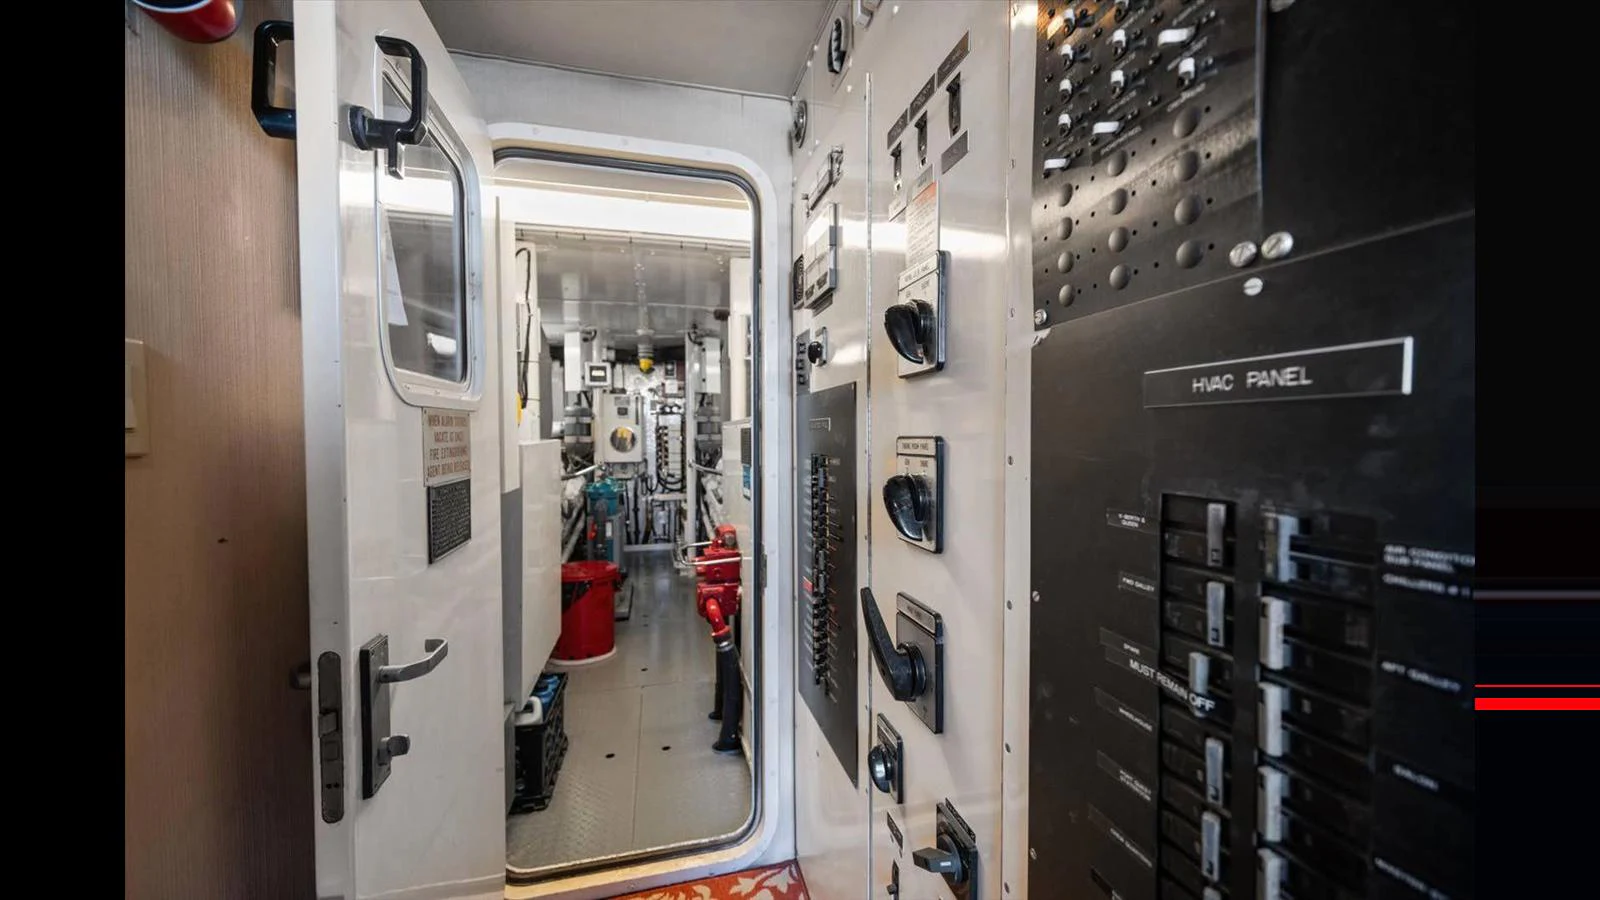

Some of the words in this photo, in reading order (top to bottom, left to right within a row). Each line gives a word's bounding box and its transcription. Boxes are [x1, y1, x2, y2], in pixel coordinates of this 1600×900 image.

[1191, 374, 1234, 393] HVAC
[1245, 366, 1314, 389] PANEL
[429, 448, 440, 460] FIRE
[1129, 659, 1156, 678] MUST
[1156, 672, 1189, 700] REMAIN
[1189, 693, 1216, 711] OFF
